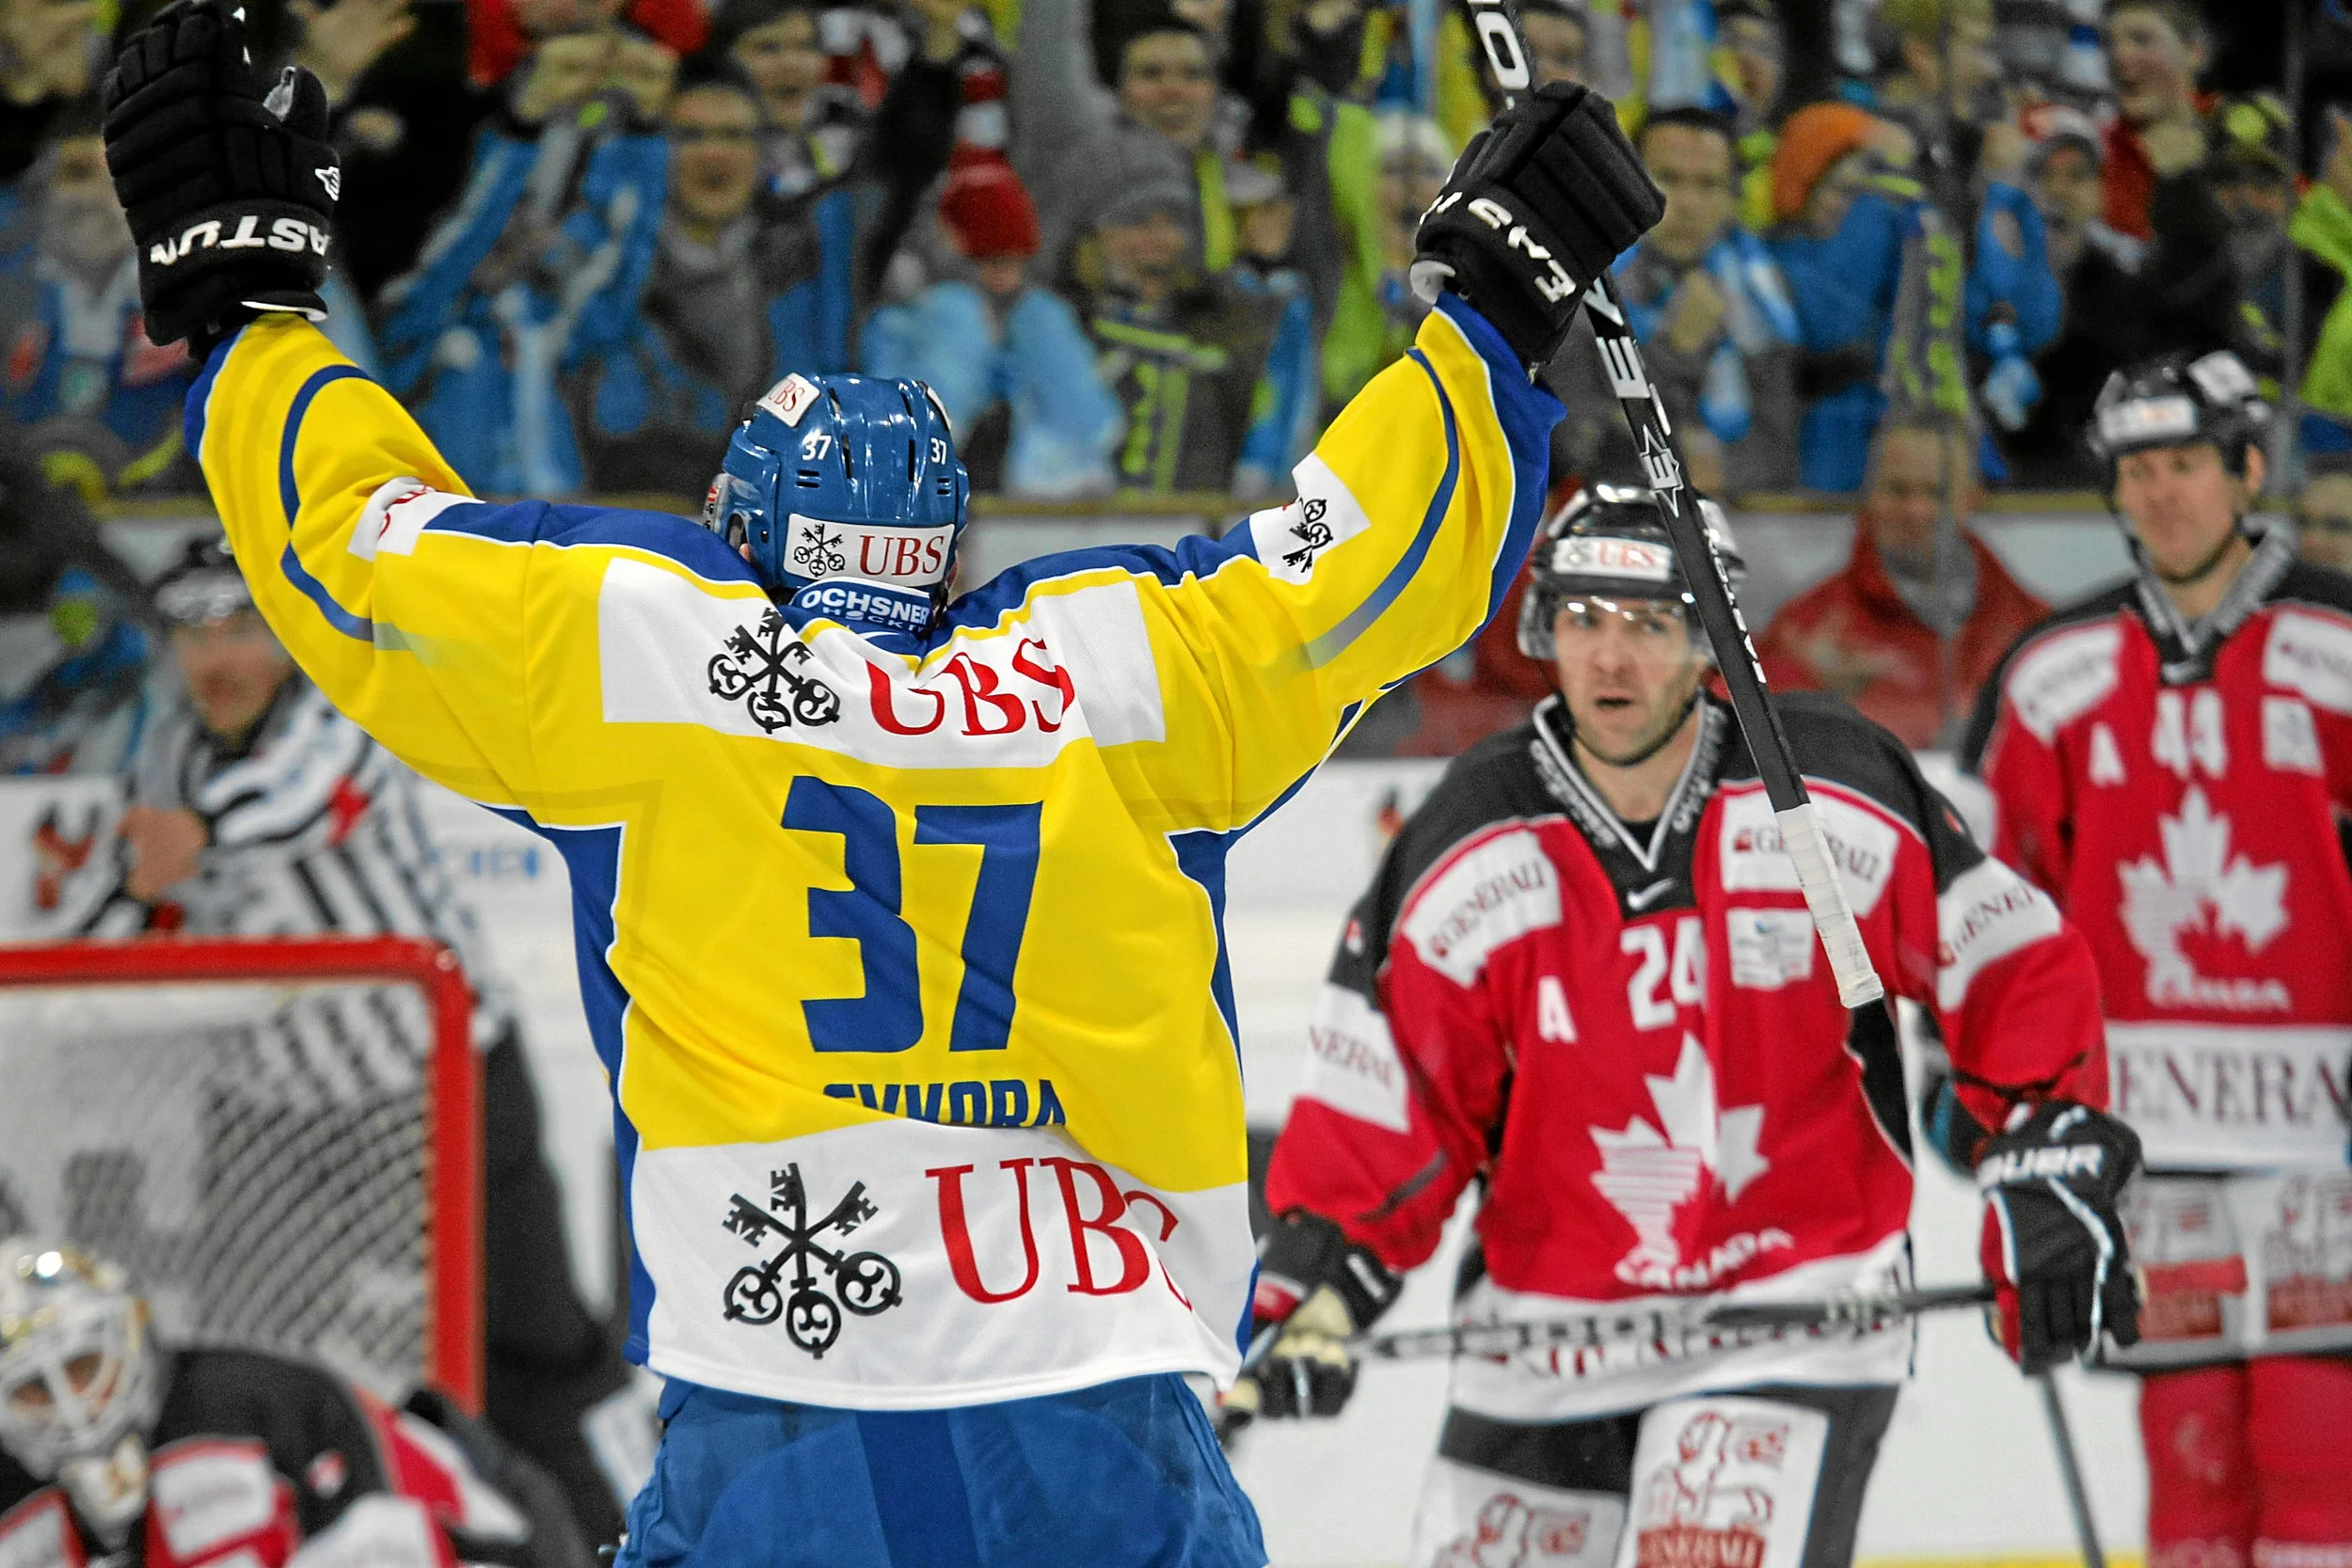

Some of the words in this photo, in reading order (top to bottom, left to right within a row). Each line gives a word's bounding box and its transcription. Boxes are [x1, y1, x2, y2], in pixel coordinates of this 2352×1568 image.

[802, 432, 833, 462] 37
[930, 436, 947, 466] 37
[859, 533, 945, 577] UBS
[801, 587, 930, 626] OCHSNER
[865, 636, 1076, 736] UBS
[780, 774, 1044, 1053] 37
[1619, 915, 1708, 1031] 24
[1536, 974, 1579, 1045] A
